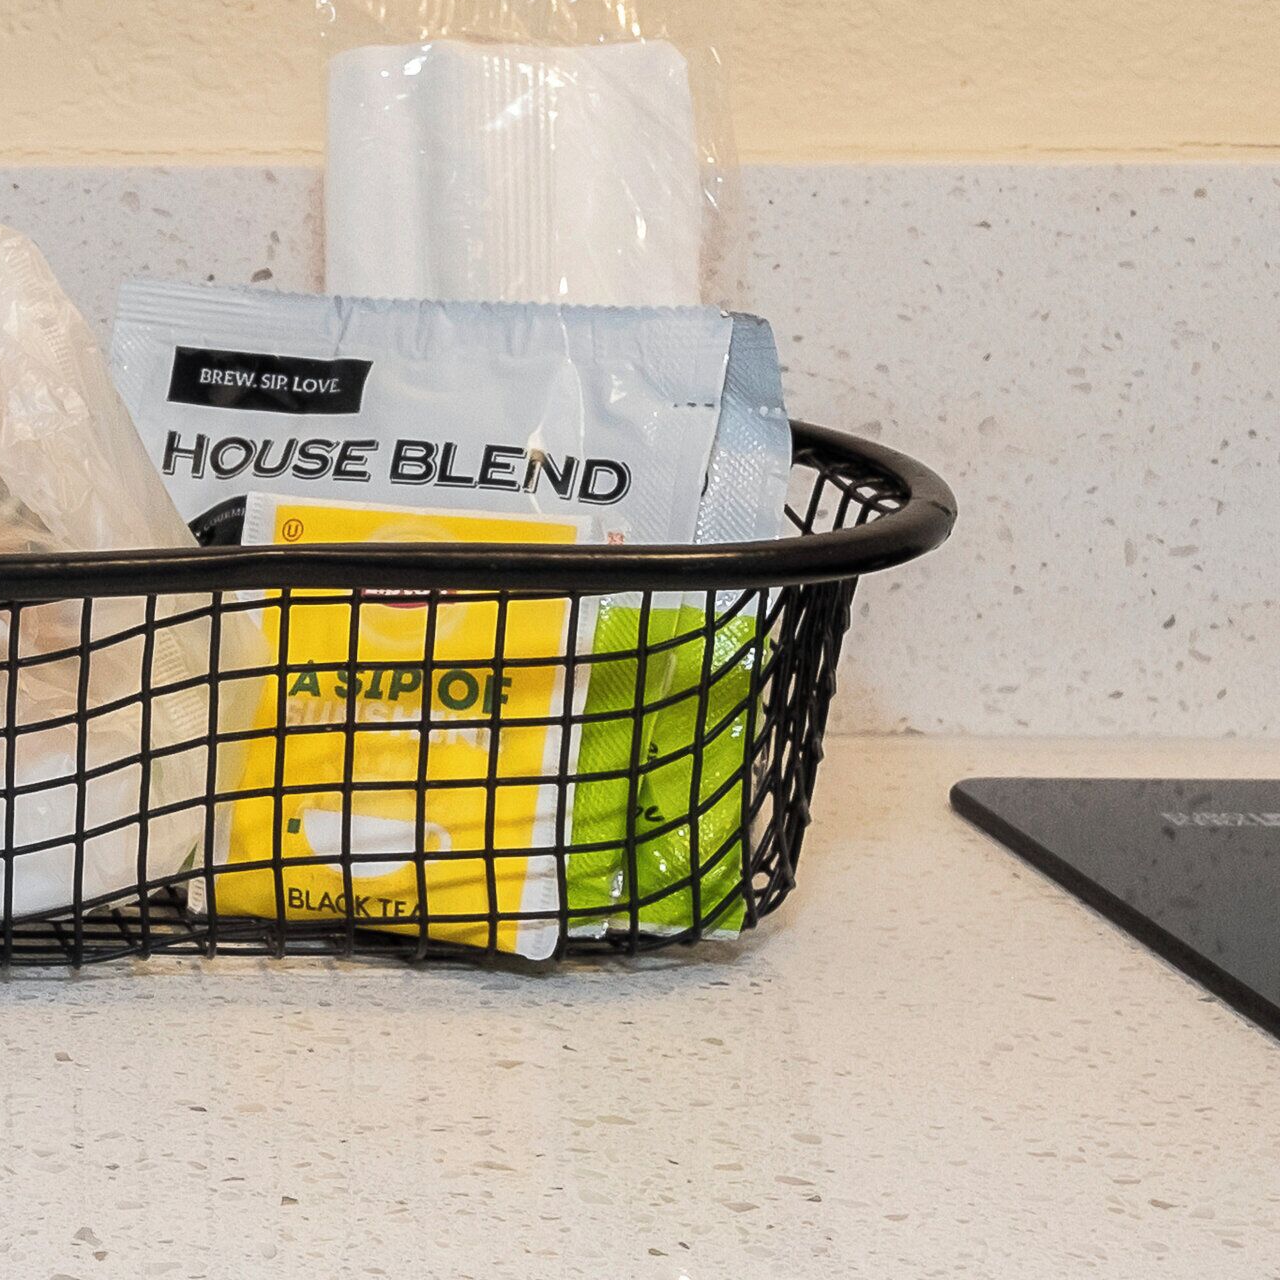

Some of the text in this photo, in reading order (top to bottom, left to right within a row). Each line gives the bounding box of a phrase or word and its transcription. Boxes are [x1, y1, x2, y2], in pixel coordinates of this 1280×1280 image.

[199, 368, 258, 388] BREW.
[161, 430, 631, 506] HOUSE BLEND
[203, 507, 246, 531] GOURM
[288, 659, 513, 714] A SIP OF
[288, 887, 371, 918] BLACK
